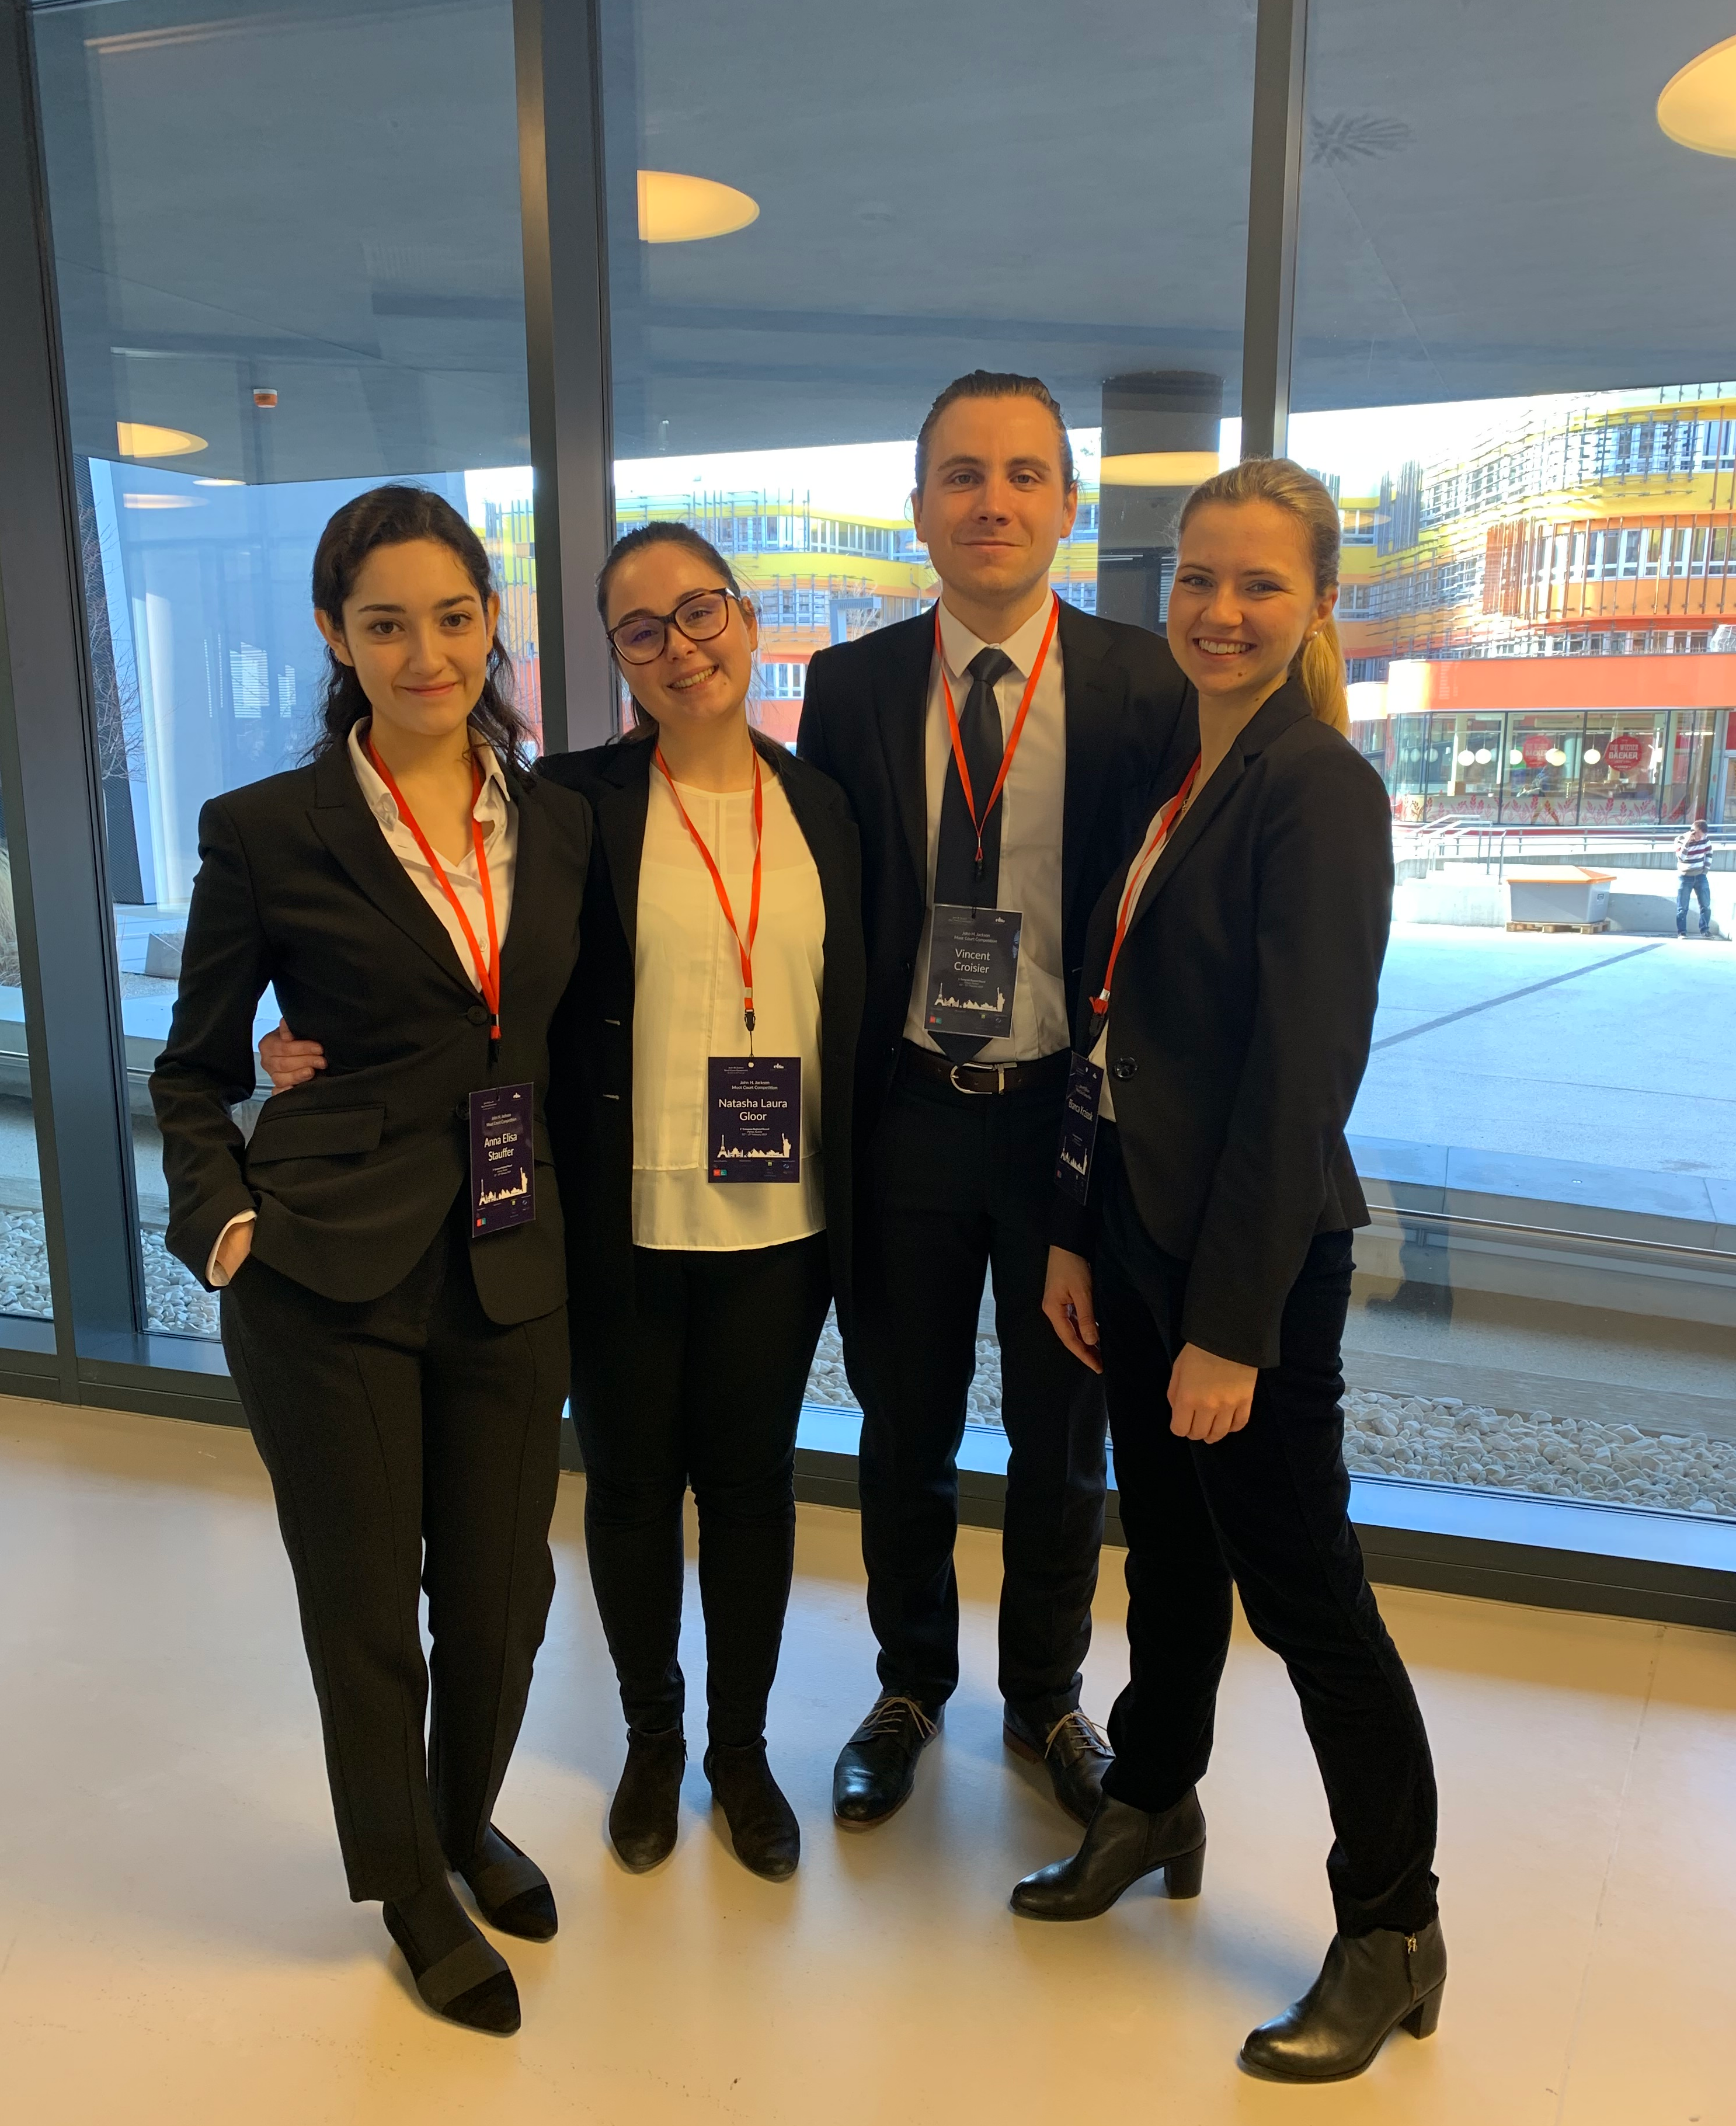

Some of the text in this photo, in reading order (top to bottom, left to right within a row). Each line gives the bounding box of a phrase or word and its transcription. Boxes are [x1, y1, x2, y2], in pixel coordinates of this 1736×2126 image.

[955, 948, 990, 961] Vincent
[954, 962, 990, 974] Croisier
[719, 1098, 788, 1108] Natasha Laura
[739, 1112, 767, 1121] Gloor
[484, 1132, 517, 1148] Anna Elisa
[488, 1147, 514, 1161] Stauffer
